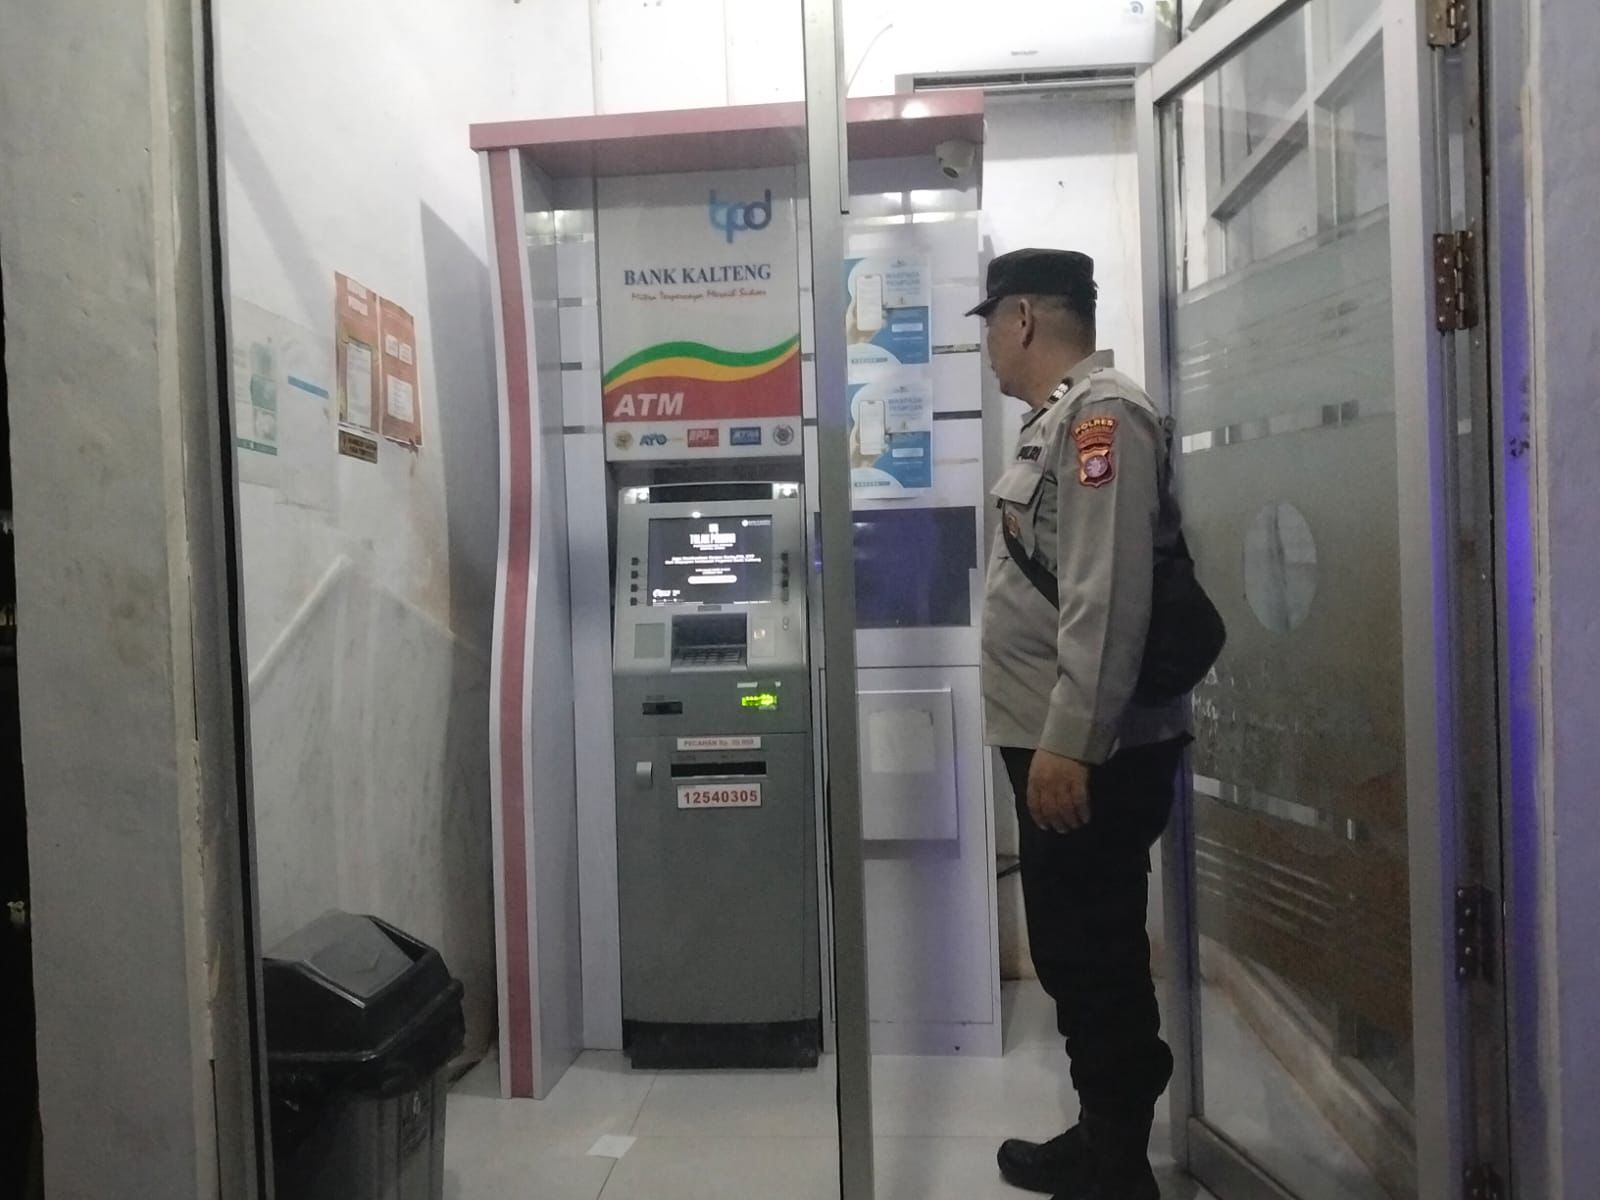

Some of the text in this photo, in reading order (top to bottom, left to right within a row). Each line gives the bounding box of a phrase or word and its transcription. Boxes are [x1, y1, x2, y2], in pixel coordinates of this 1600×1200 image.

[624, 264, 771, 286] BANK KALTENG
[613, 392, 684, 417] ATM
[1075, 419, 1114, 434] POLRES
[684, 790, 758, 804] 12540305
